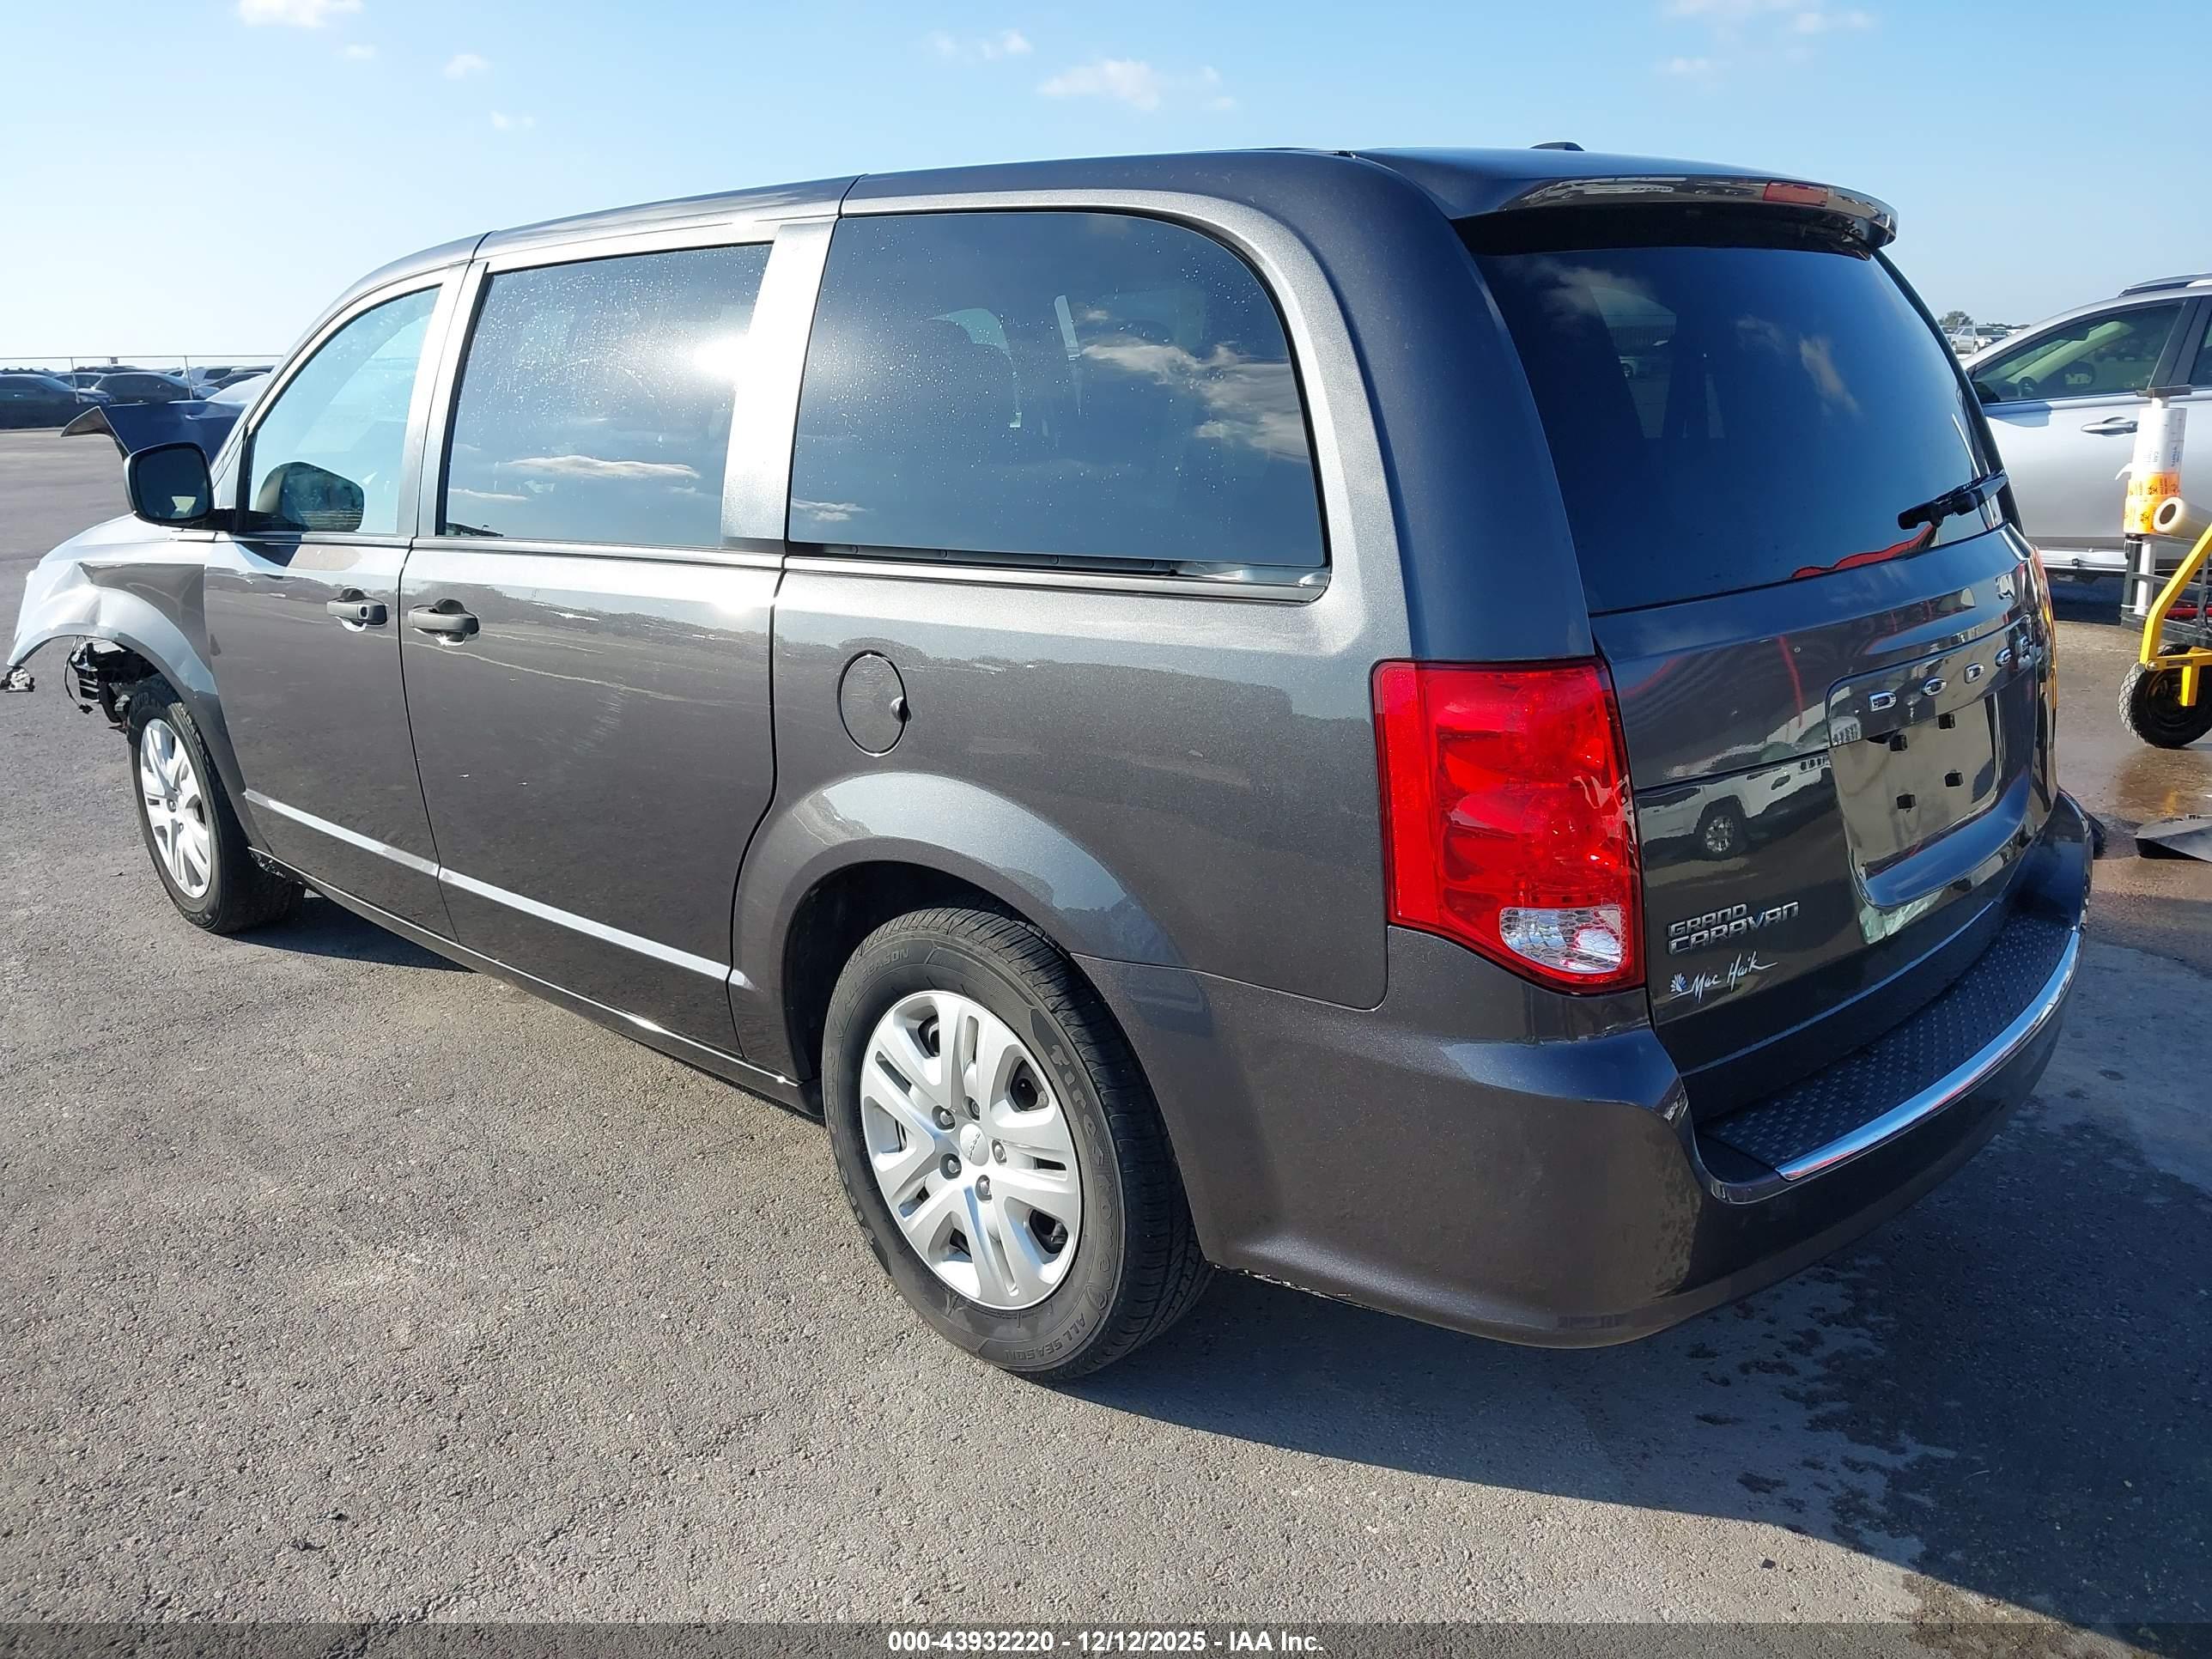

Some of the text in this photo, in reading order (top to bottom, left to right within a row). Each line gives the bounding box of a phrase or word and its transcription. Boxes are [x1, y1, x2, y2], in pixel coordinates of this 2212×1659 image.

[1869, 635, 2032, 713] DODGE
[1668, 903, 1747, 938] GRAND
[1668, 901, 1800, 955] CARAVAN
[1671, 951, 1778, 1003] Mac Haik
[1004, 1311, 1086, 1360] ALL SEASON
